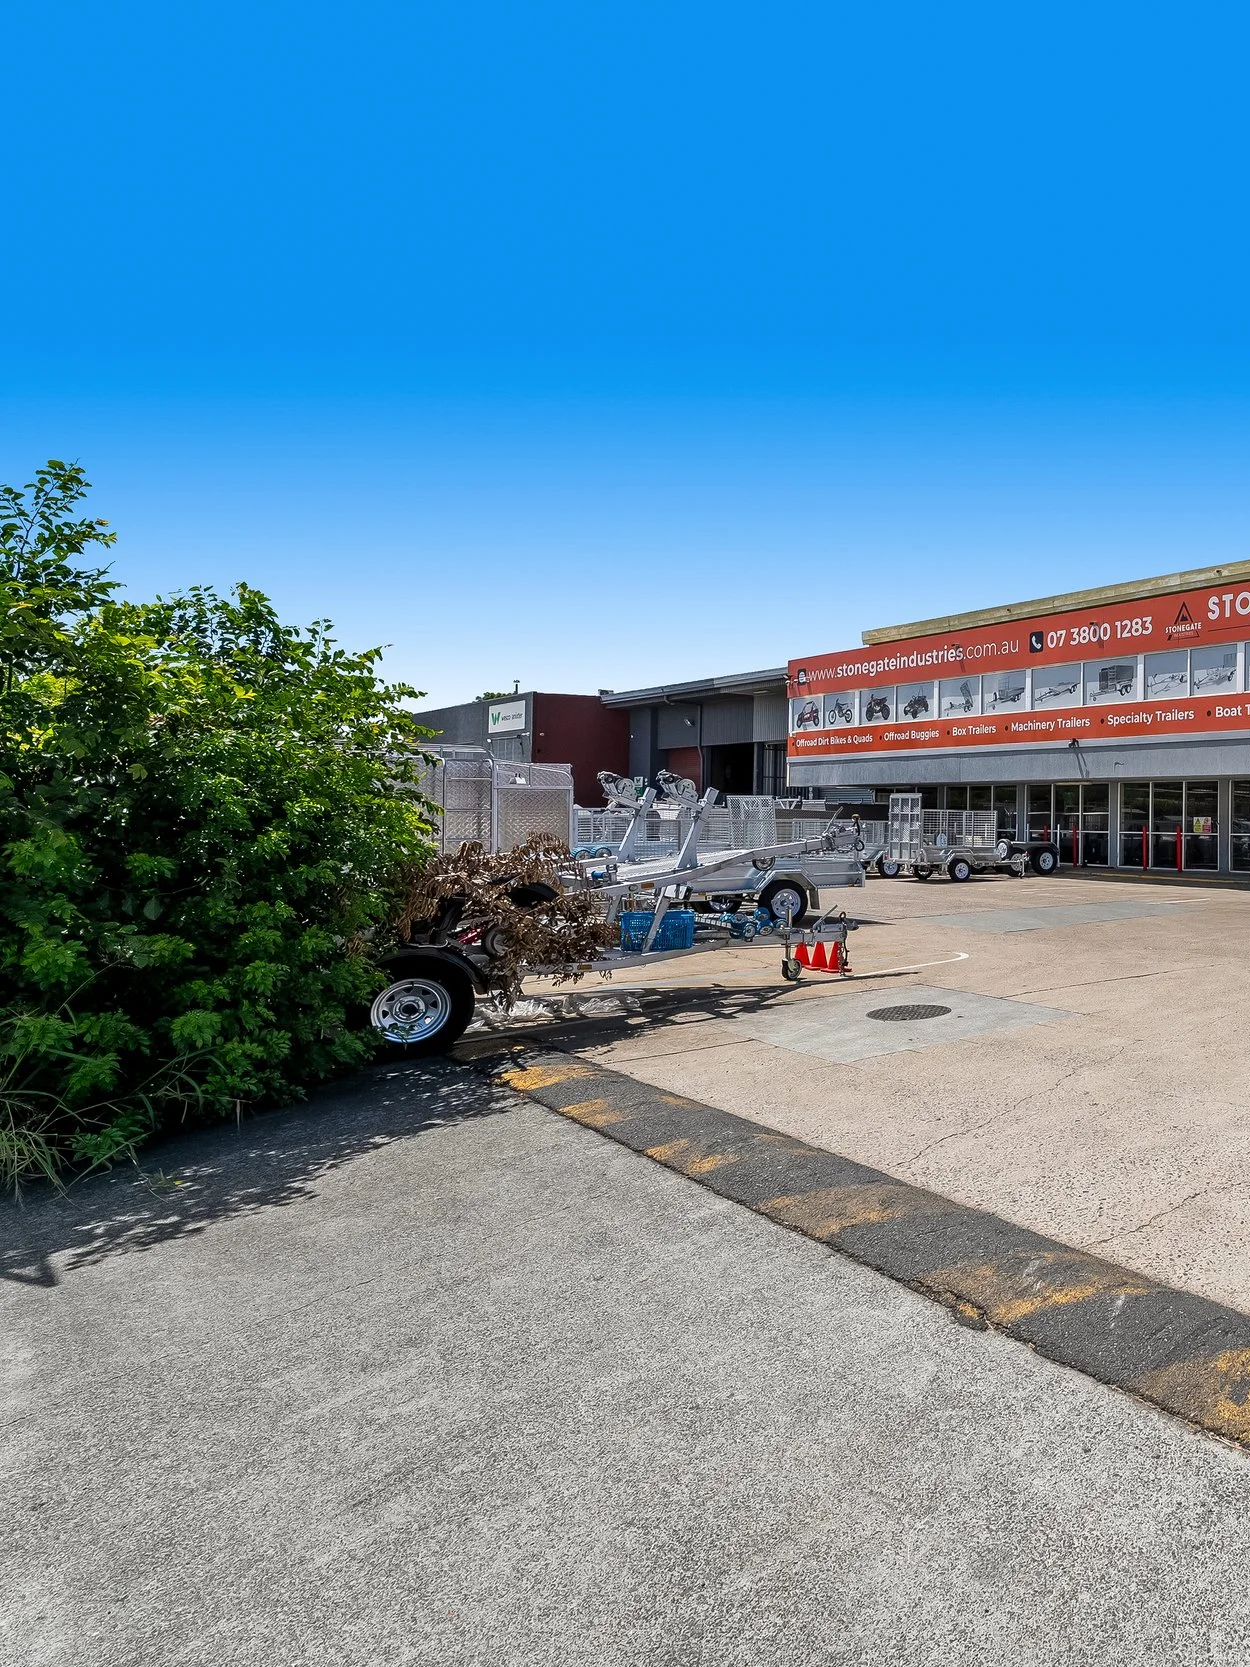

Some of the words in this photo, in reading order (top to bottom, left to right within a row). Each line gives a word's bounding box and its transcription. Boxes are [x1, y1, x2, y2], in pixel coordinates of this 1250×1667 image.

[1047, 629, 1067, 649] 07
[1070, 622, 1112, 646] 3800
[1115, 616, 1153, 639] 1283
[1165, 622, 1202, 634] STONEGATE
[808, 639, 1019, 682] www.stonegateindustries.com.au
[1107, 711, 1153, 726] Specialty
[1155, 708, 1195, 722] Trailers
[1215, 705, 1242, 718] Boat
[952, 726, 967, 737] Box
[968, 723, 997, 735] Trailers
[1011, 720, 1055, 732] Machinery
[1057, 716, 1091, 729] Trailers
[796, 737, 818, 748] Offroad
[818, 737, 830, 746] Dirt
[830, 735, 847, 745] Bikes
[847, 735, 852, 744] &
[853, 734, 873, 744] Quads
[884, 730, 910, 741] Offroad
[911, 729, 940, 741] Buggies
